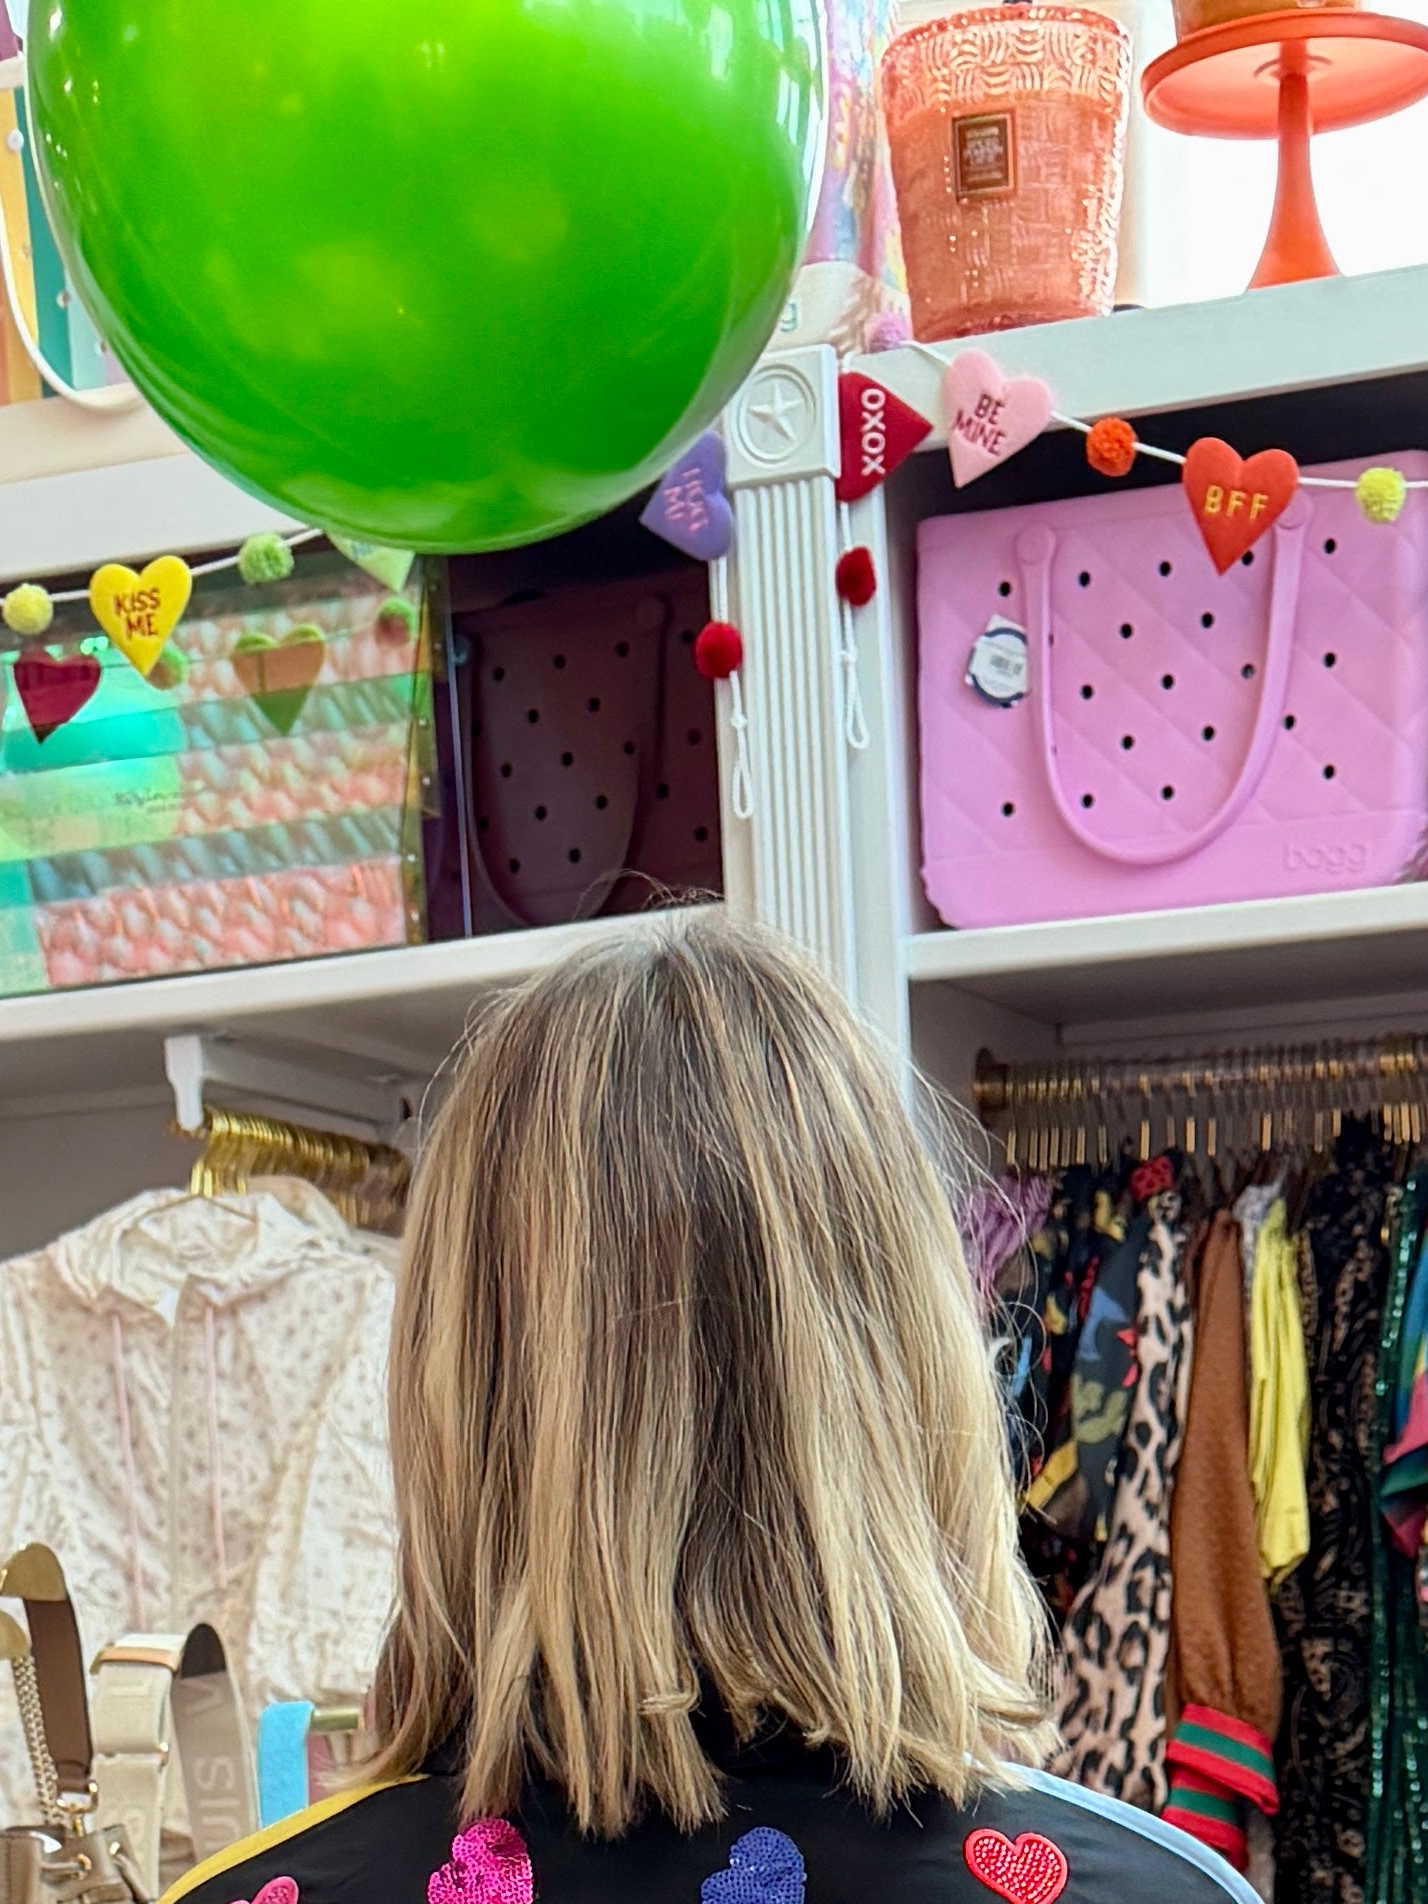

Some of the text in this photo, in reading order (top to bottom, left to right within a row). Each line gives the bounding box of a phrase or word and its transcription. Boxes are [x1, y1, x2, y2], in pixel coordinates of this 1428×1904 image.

[974, 393, 1006, 425] BE
[860, 388, 887, 477] XOXO
[953, 410, 1008, 456] MINE
[1203, 485, 1269, 520] BFF
[115, 588, 161, 615] KISS
[125, 612, 158, 640] ME
